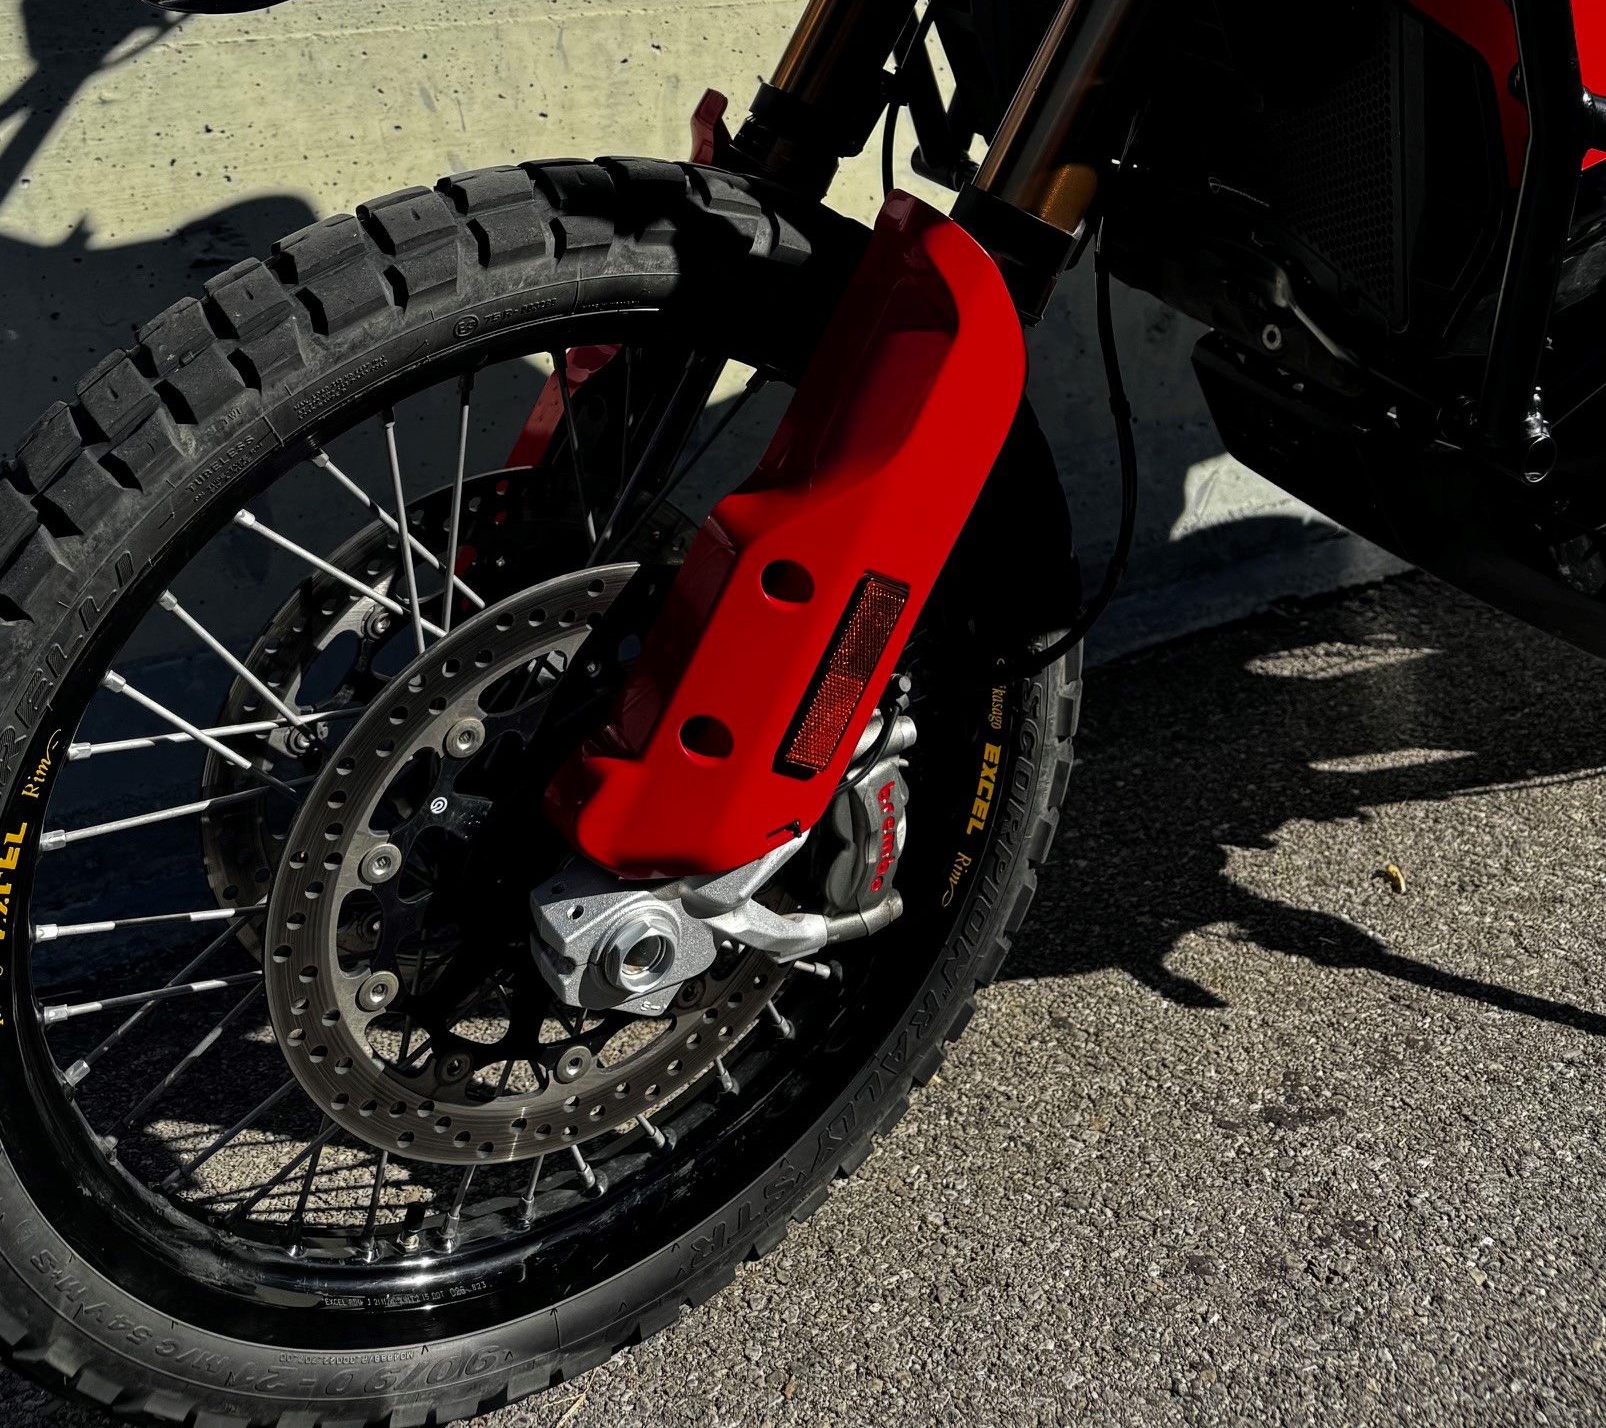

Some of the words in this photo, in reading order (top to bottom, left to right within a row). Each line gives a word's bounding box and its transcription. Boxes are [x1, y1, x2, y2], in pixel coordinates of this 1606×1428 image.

[185, 435, 254, 493] TUBELESS
[0, 550, 135, 786] RELLI
[21, 729, 61, 800] Rim
[966, 742, 1002, 835] EXCEL
[871, 780, 896, 892] brembo
[941, 677, 1043, 990] SCORPION
[941, 851, 972, 908] Rim
[811, 989, 941, 1173] RALLY
[690, 1164, 796, 1264] STR
[325, 1297, 347, 1307] EXCEL
[155, 1338, 229, 1373] M/C
[325, 1345, 500, 1396] 90/90
